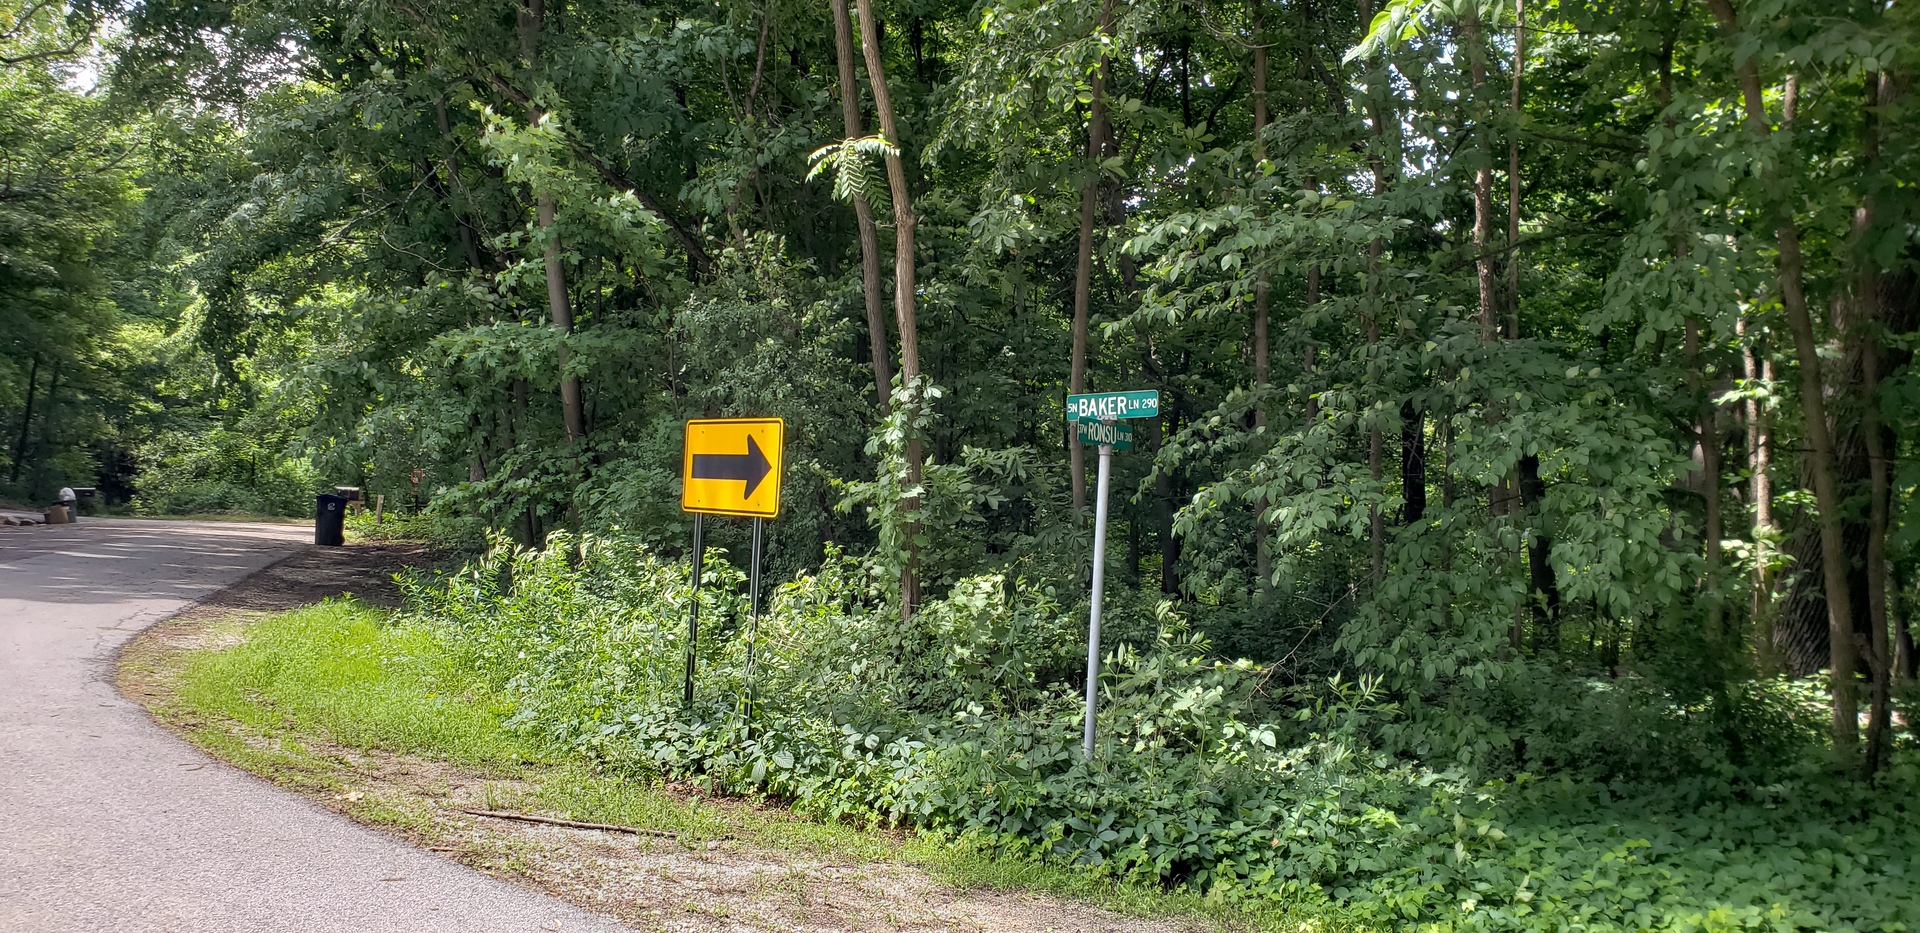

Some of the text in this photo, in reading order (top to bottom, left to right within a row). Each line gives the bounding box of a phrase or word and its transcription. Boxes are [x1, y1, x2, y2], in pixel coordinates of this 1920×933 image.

[1068, 396, 1158, 416] 5N BAKER LN 290
[1088, 421, 1117, 444] RONSU
[1117, 431, 1124, 441] LN
